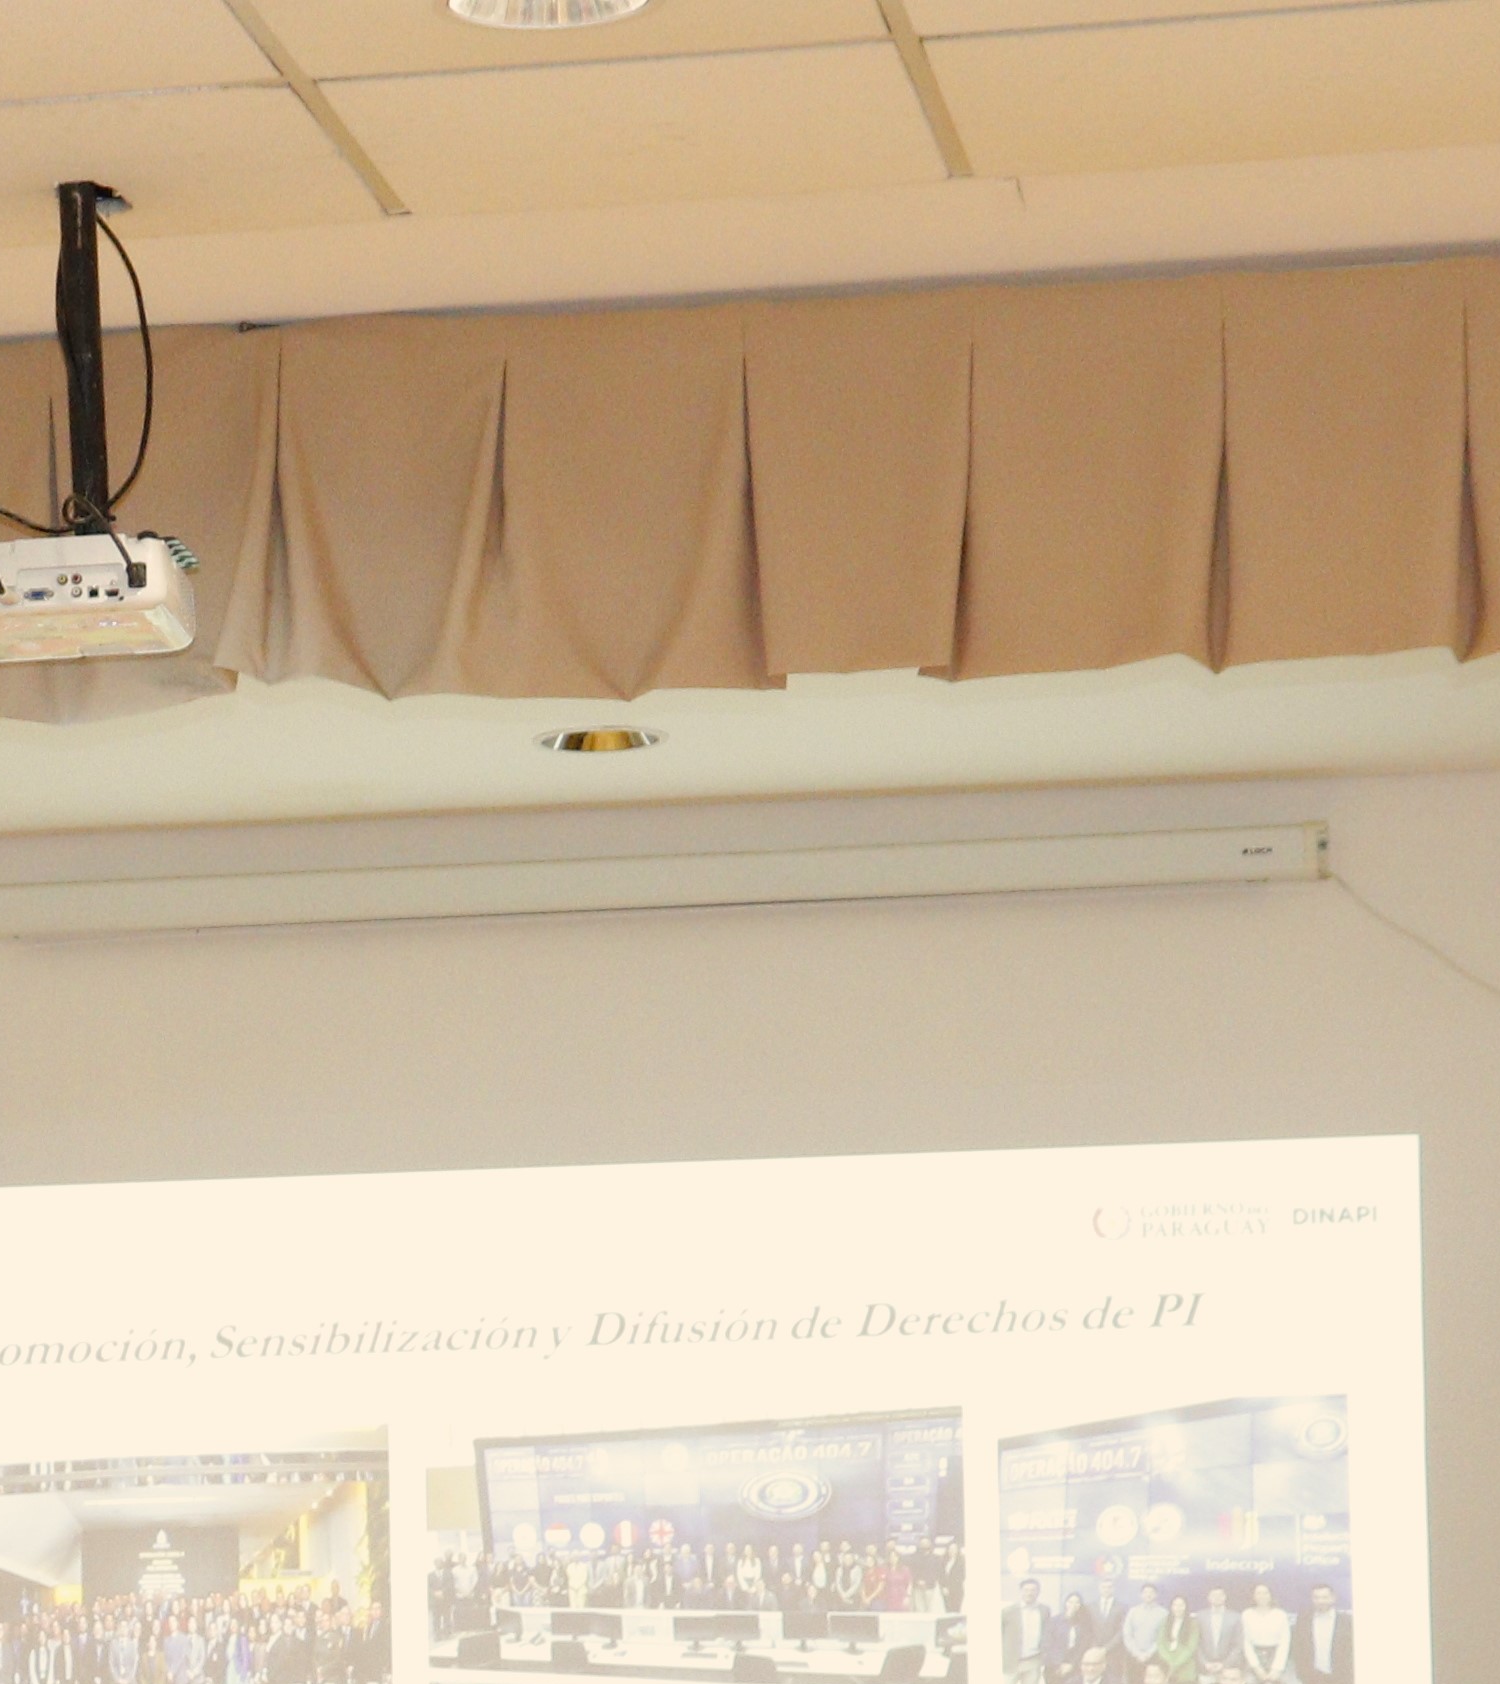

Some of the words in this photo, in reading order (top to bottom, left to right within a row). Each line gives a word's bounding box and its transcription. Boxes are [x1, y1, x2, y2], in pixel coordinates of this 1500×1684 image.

[1292, 1205, 1378, 1226] DINAPI
[1141, 1217, 1270, 1239] PARAGUAY
[209, 1314, 539, 1360] Sensibilización
[542, 1326, 573, 1360] y
[585, 1306, 778, 1347] Difusión
[790, 1305, 842, 1342] de
[856, 1299, 1069, 1338] Derechos
[1081, 1295, 1135, 1332] de
[1149, 1292, 1208, 1329] PI
